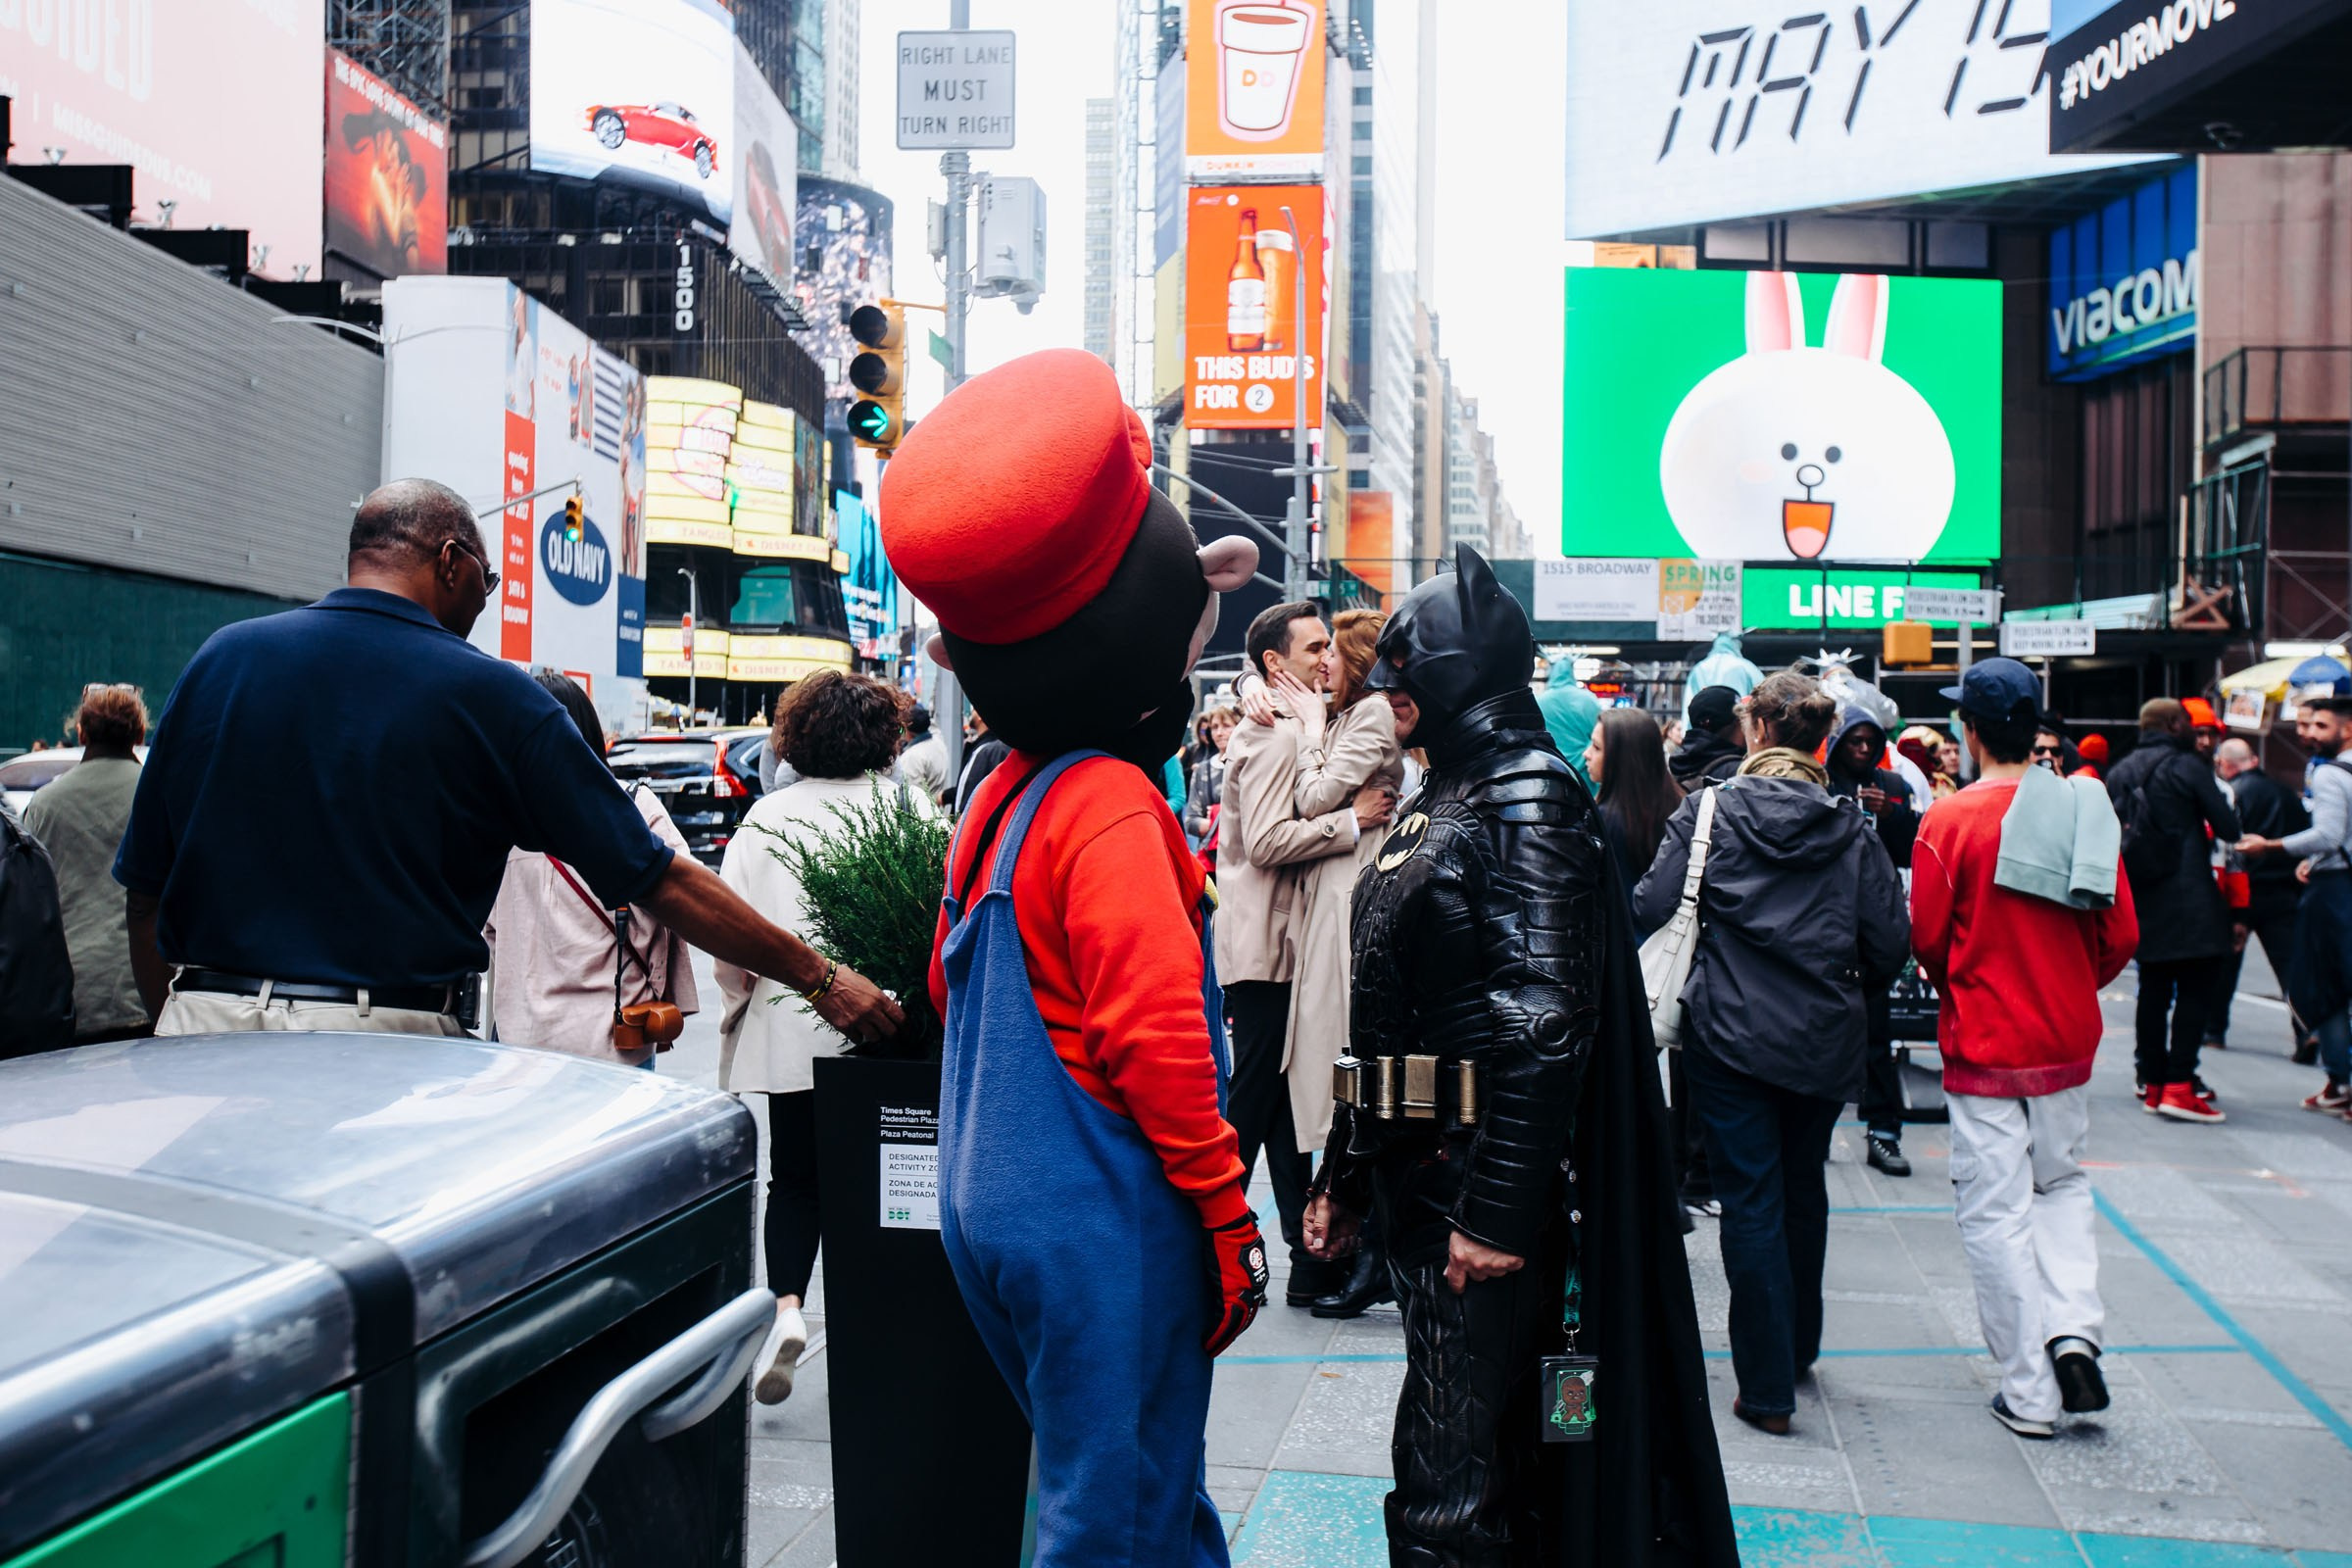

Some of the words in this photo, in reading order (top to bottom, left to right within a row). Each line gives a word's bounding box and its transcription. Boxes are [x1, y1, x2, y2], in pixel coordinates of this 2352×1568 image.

[902, 47, 955, 65] RIGHT
[964, 47, 1010, 65] LANE
[924, 79, 988, 101] MUST
[1656, 0, 1920, 164] MAY
[901, 117, 948, 134] TURN
[958, 117, 1011, 134] RIGHT
[675, 244, 694, 331] 1500
[1195, 356, 1246, 380] THIS
[1195, 384, 1239, 409] FOR
[547, 529, 573, 575] OLD
[573, 540, 606, 585] NAVY
[1544, 564, 1574, 575] 1515
[1577, 564, 1652, 575] BROADWAY
[1665, 564, 1737, 582] SPRING
[1789, 584, 1875, 618] LINE
[880, 1106, 904, 1115] Times
[905, 1107, 932, 1117] Square
[880, 1115, 919, 1124] Pedestrian
[889, 1153, 939, 1162] DESIGNATED
[888, 1190, 937, 1199] DESIGNADA
